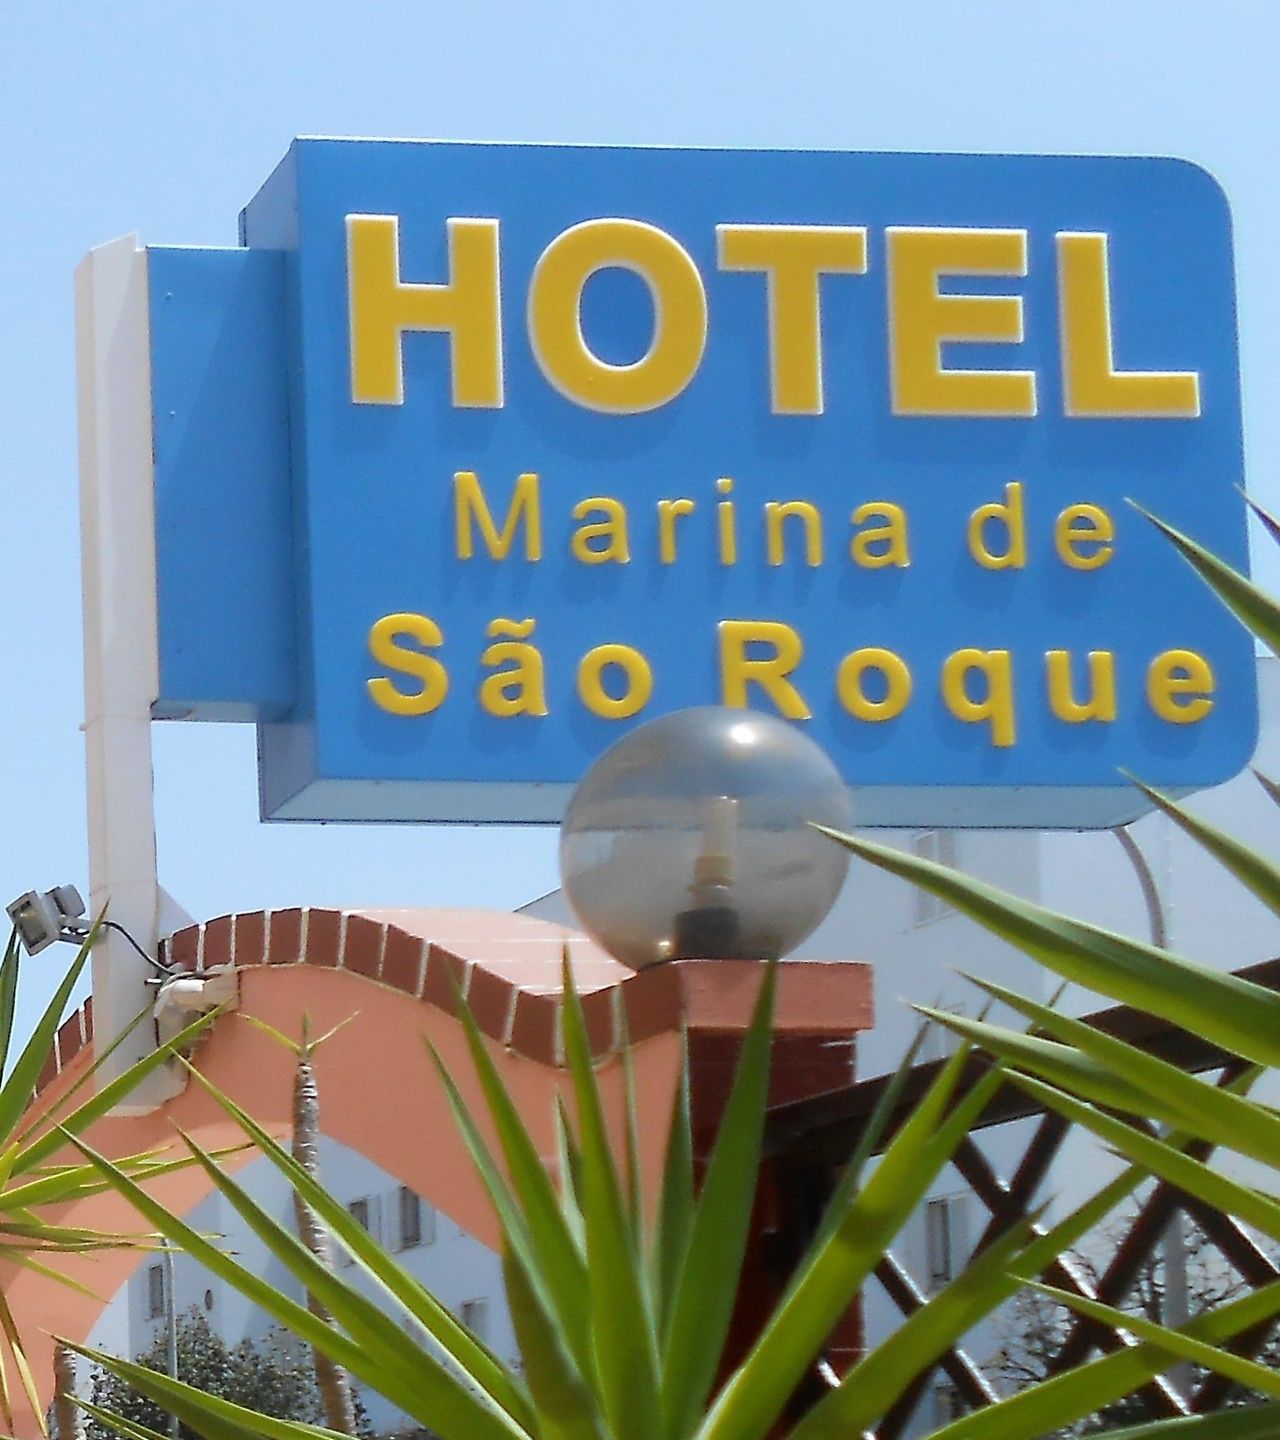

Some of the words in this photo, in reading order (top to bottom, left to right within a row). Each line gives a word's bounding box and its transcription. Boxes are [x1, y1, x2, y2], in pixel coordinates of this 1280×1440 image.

[345, 213, 1201, 417] HOTEL
[454, 471, 912, 570] Marina
[967, 482, 1117, 572] de
[365, 612, 653, 720] São
[717, 619, 1217, 749] Roque
